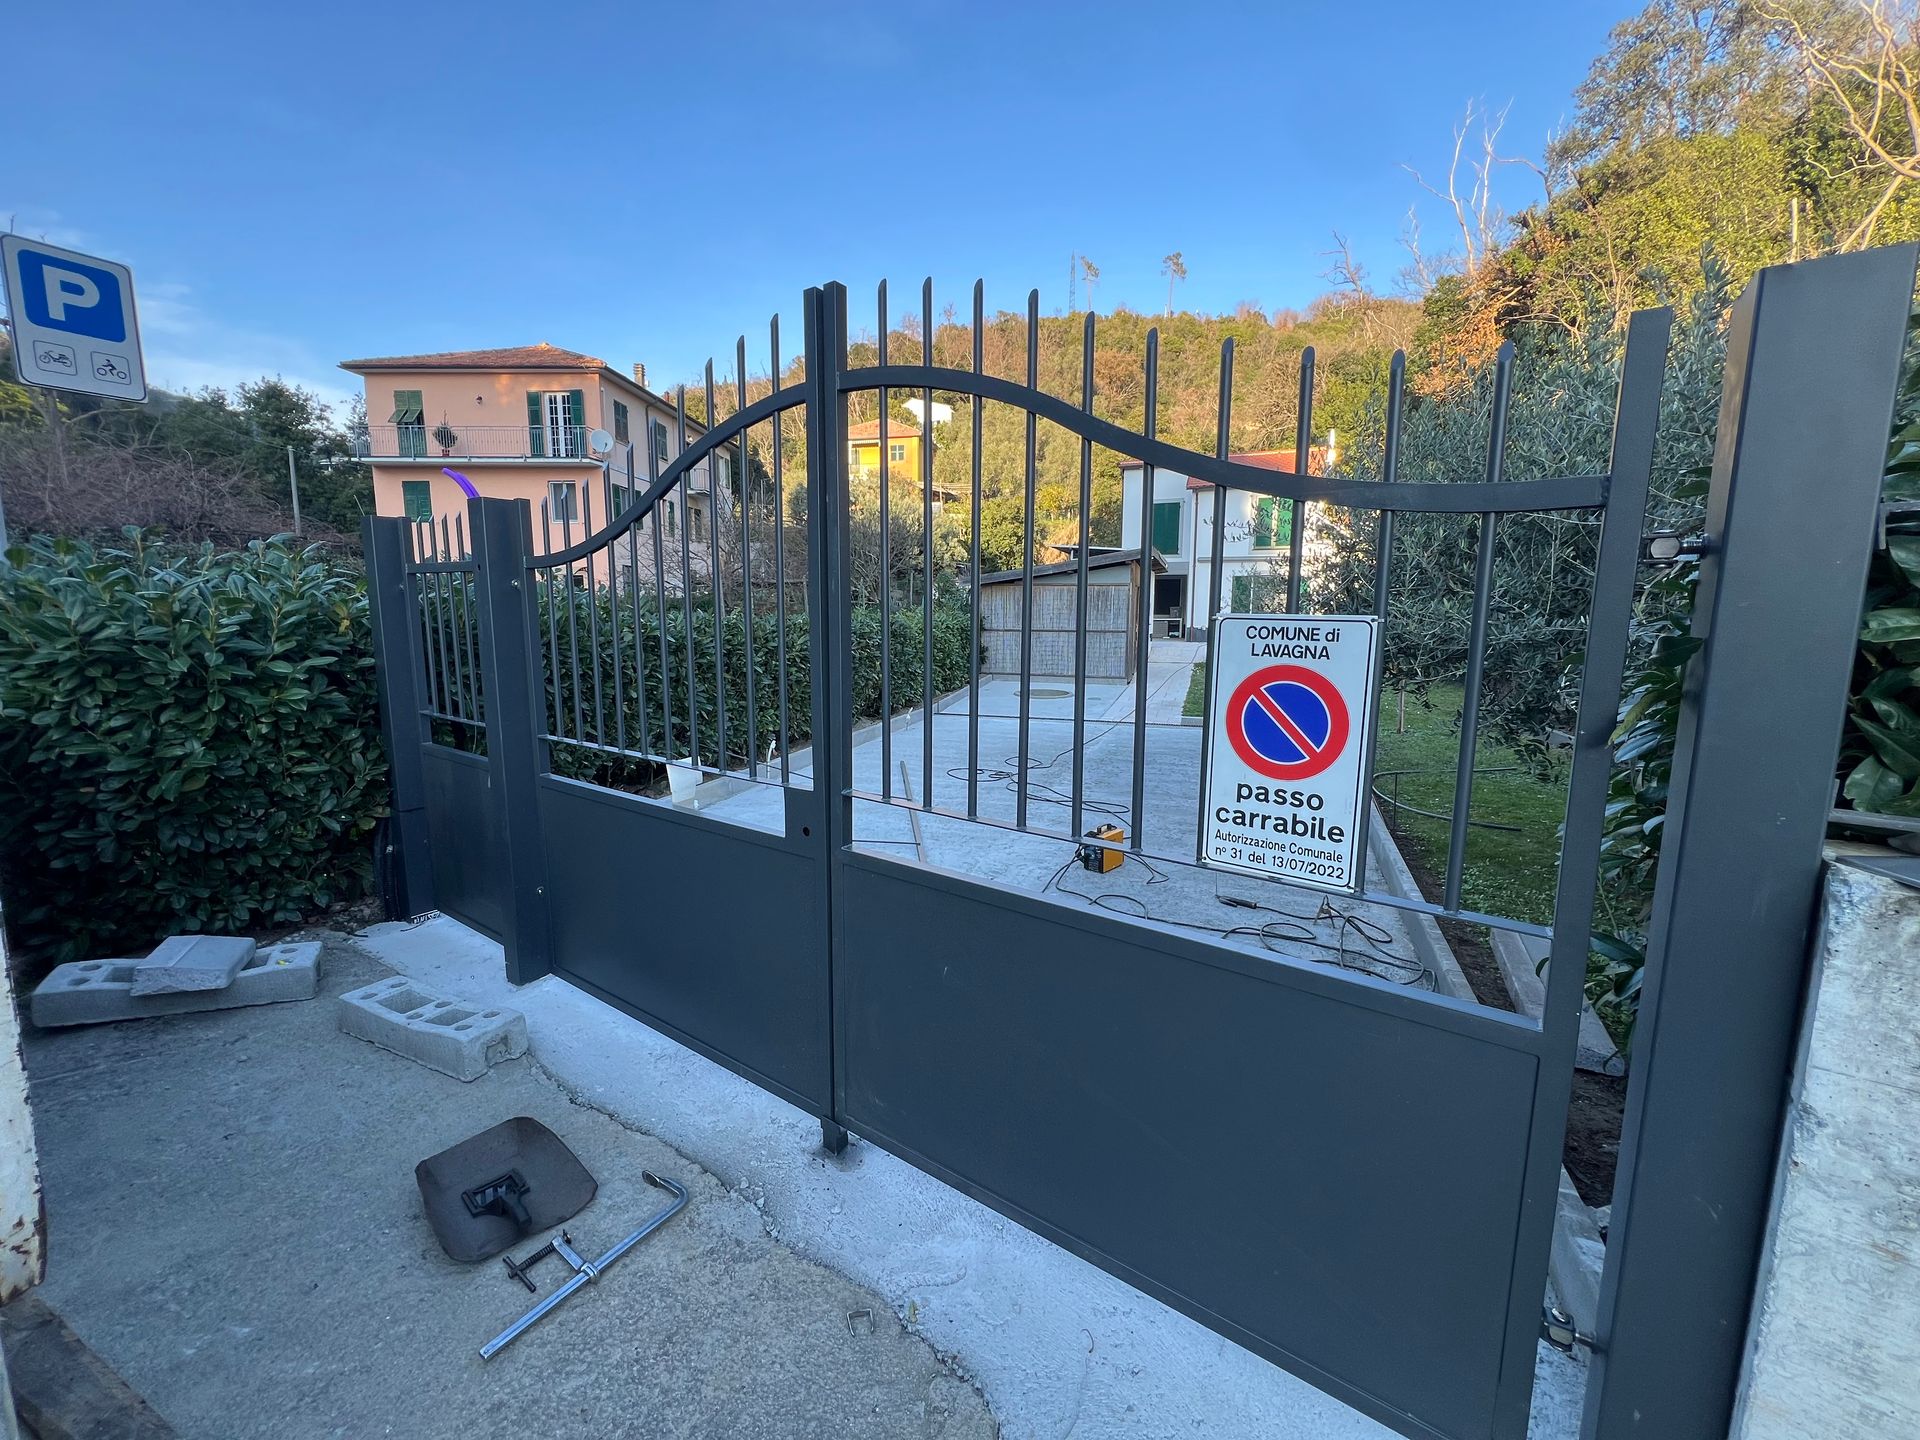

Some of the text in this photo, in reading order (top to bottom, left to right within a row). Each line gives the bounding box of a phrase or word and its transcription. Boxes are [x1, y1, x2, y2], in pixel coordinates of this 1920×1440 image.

[42, 264, 100, 321] P
[1246, 625, 1340, 643] COMUNE di
[1250, 642, 1331, 660] LAVAGNA
[1236, 782, 1324, 811] passo
[1215, 806, 1345, 844] carrabile
[1215, 829, 1343, 863] Autorizzazione Comunale
[1230, 848, 1242, 860] 31
[1248, 851, 1266, 865] del
[1272, 856, 1344, 880] 13/07/2022
